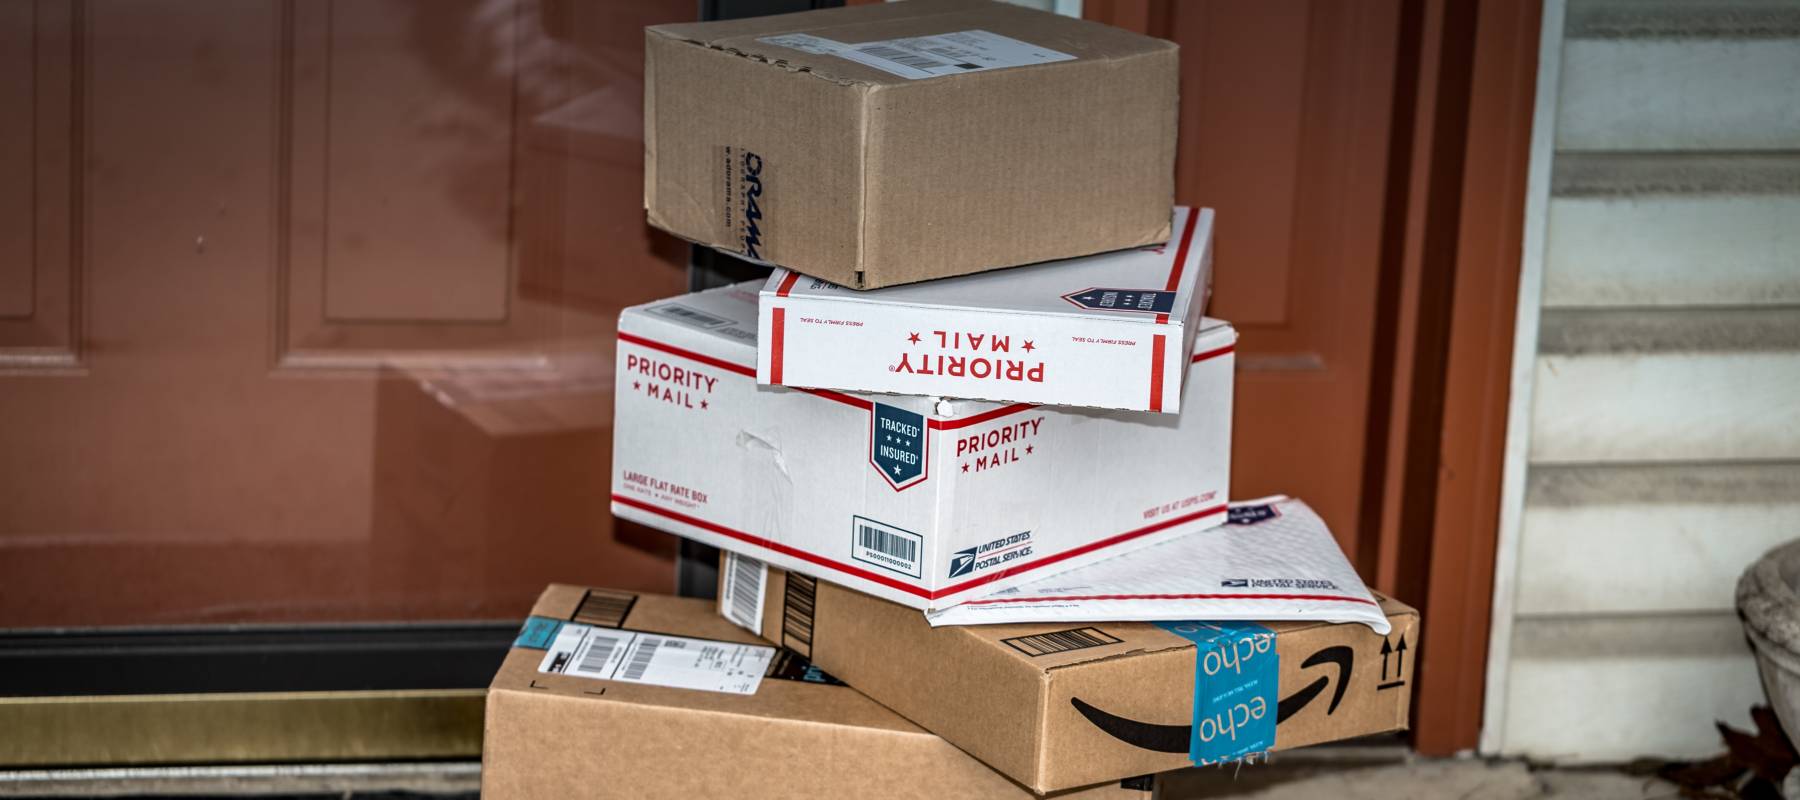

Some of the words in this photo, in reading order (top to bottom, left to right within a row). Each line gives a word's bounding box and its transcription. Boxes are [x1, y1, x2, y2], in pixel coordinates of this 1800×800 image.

[934, 331, 1010, 353] MAIL
[648, 383, 693, 409] MAIL
[976, 447, 1019, 472] MAIL
[623, 470, 648, 486] LARGE
[650, 478, 669, 492] FLAT
[670, 484, 689, 498] RATE
[692, 490, 708, 503] BOX
[978, 538, 1006, 554] UNITED
[1006, 531, 1031, 546] STATES
[974, 556, 1002, 571] POSTAL
[1204, 633, 1271, 675] echo
[1201, 696, 1266, 742] echo
